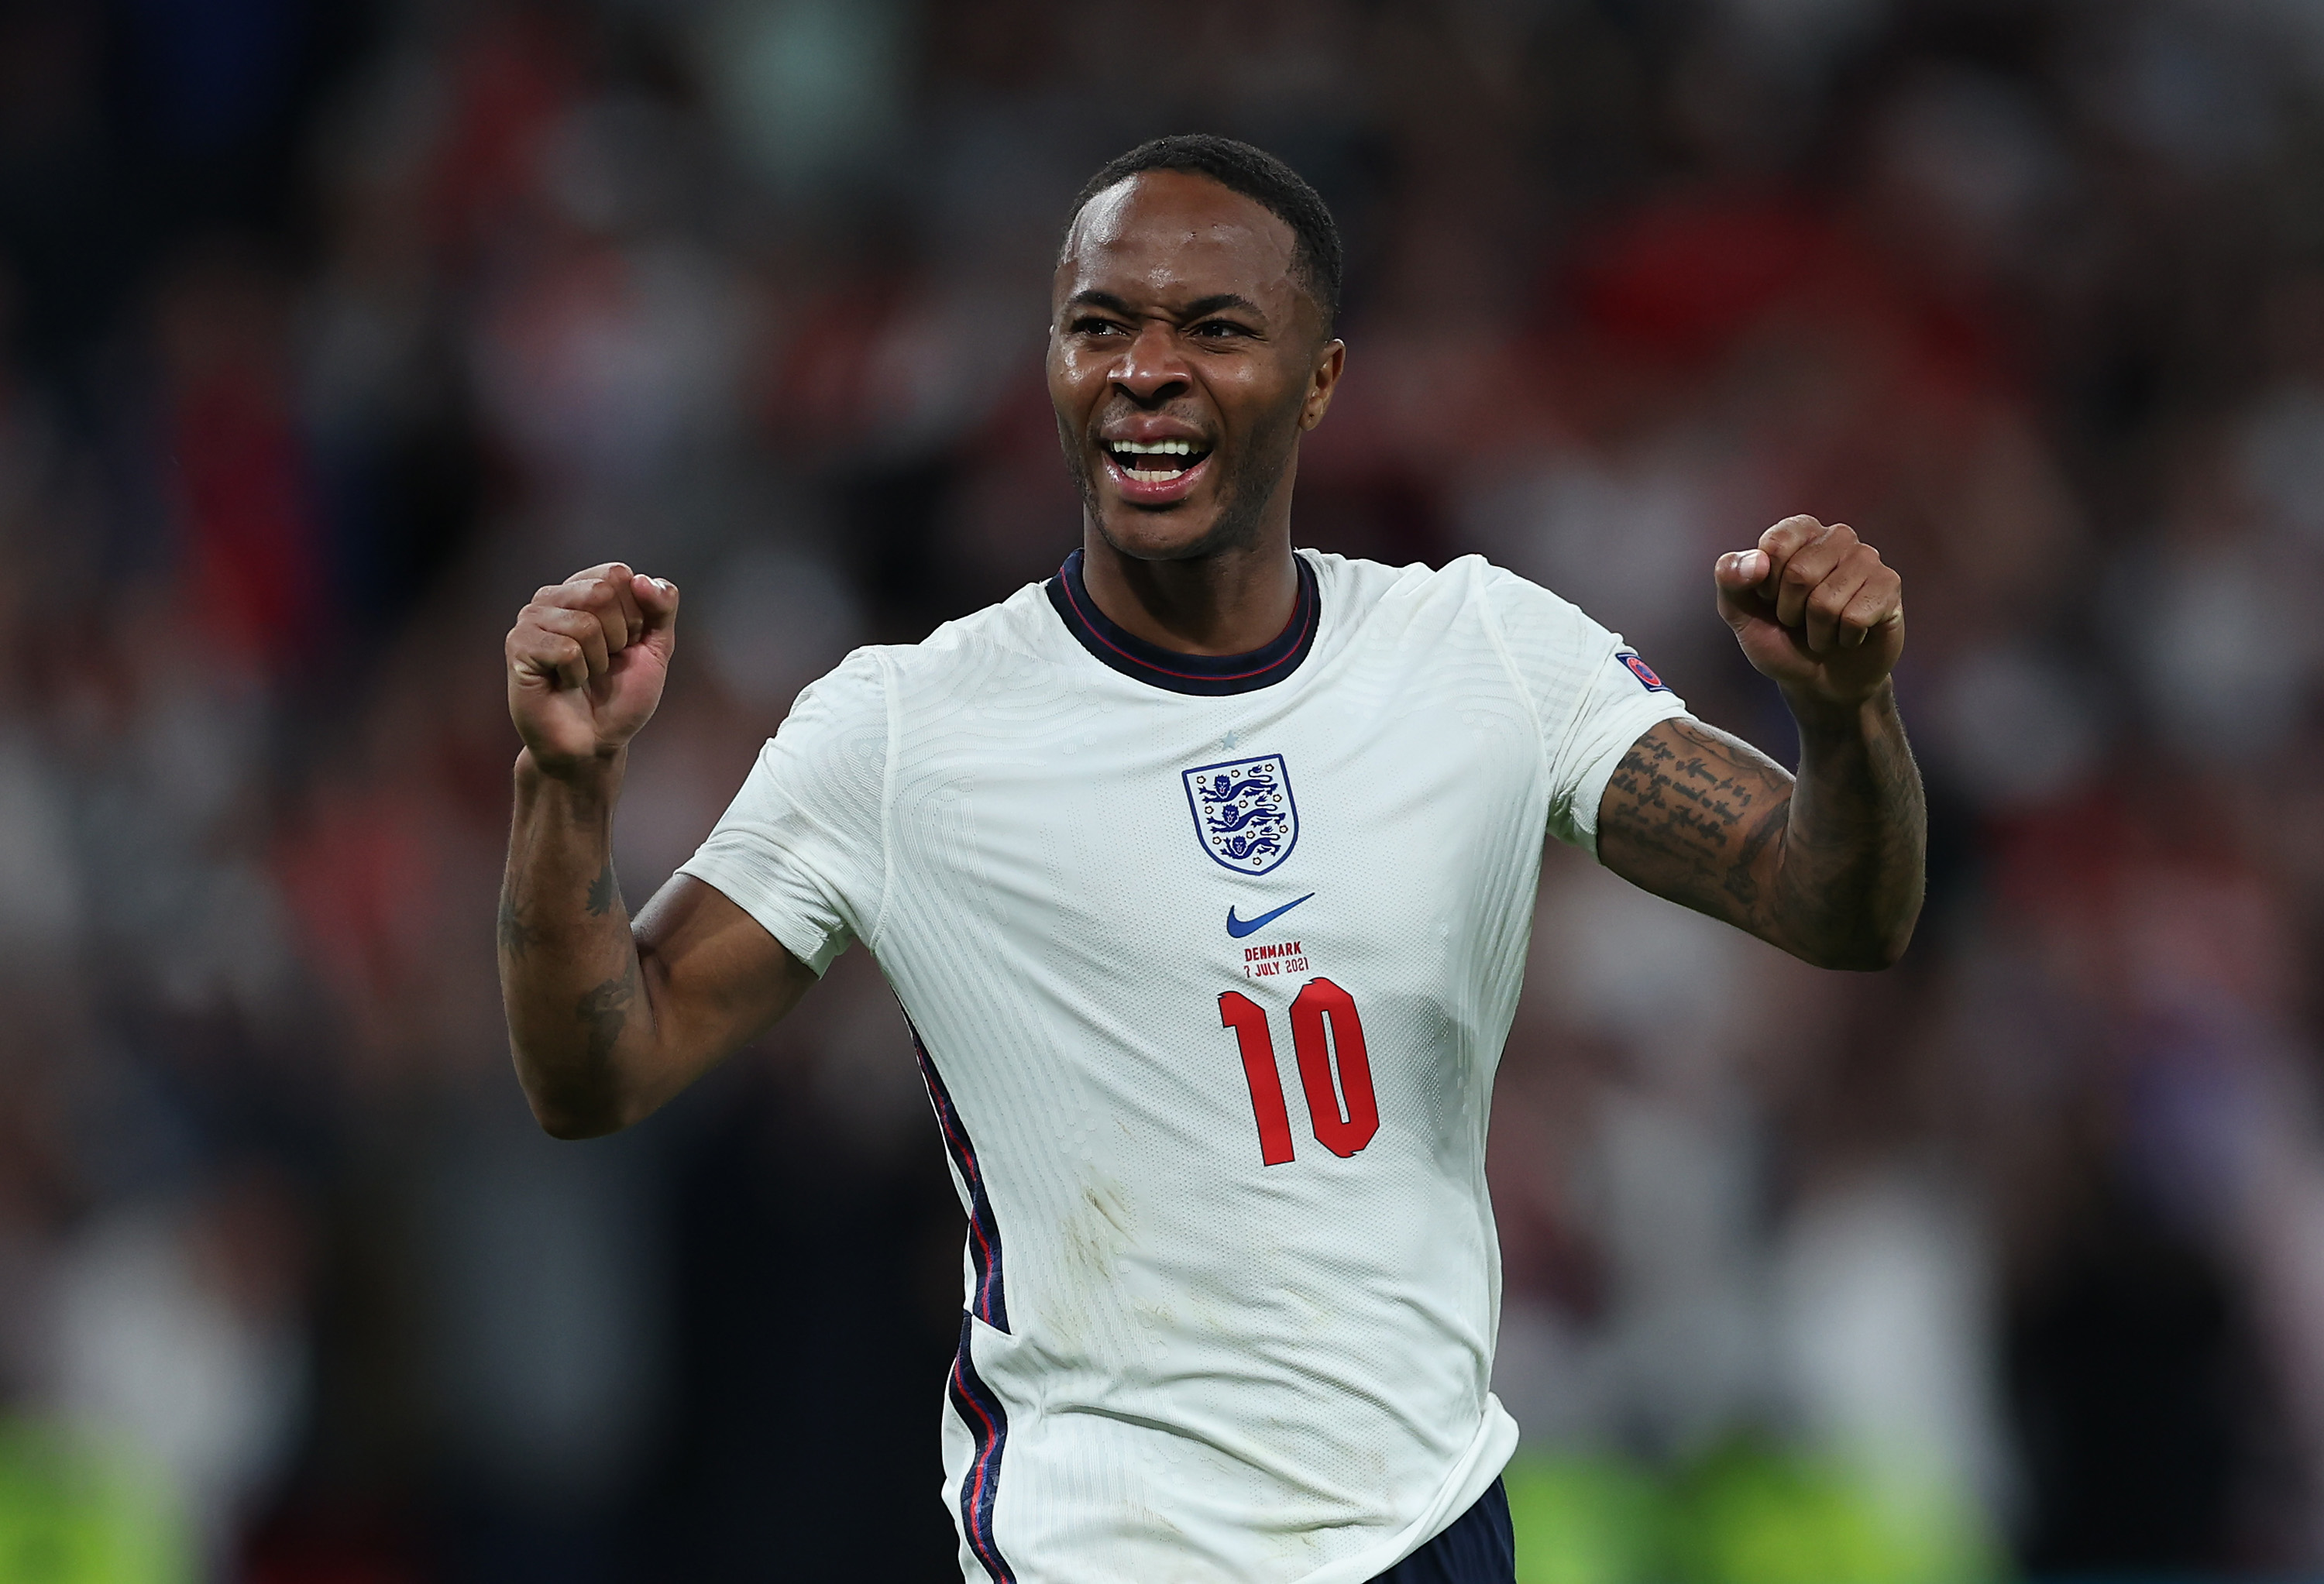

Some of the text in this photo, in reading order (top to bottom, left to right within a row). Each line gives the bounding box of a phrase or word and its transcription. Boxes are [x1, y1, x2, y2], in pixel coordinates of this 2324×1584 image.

[1244, 941, 1301, 962] DENMARK
[1243, 957, 1309, 978] 7 JULY 2021
[1217, 977, 1380, 1167] 10
